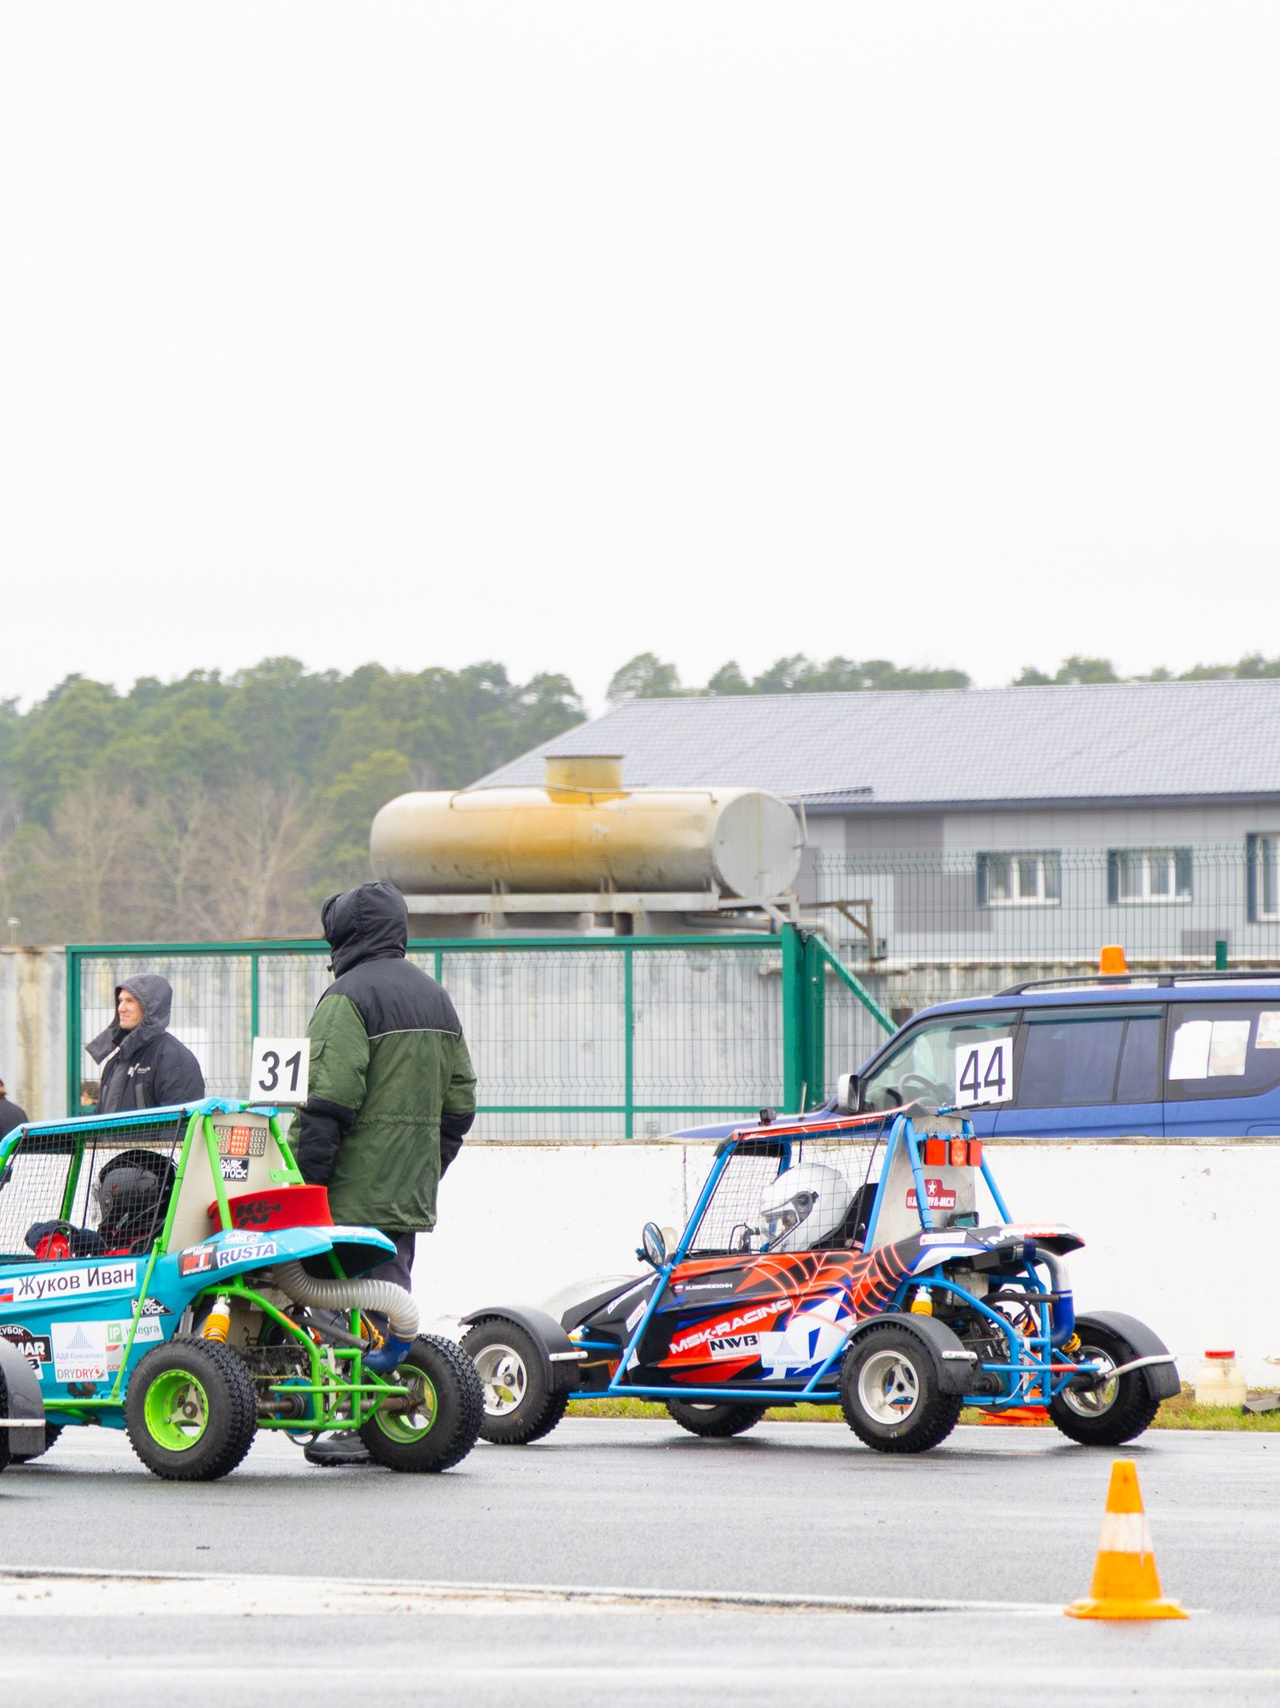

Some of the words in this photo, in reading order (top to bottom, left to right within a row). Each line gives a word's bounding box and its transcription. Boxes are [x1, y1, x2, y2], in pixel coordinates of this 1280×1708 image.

[258, 1050, 302, 1092] 31
[959, 1046, 1006, 1101] 44
[219, 1243, 275, 1266] RUSTA
[18, 1275, 80, 1299] Жуков
[87, 1267, 134, 1288] Иван
[126, 1325, 160, 1336] iegra
[669, 1299, 792, 1354] MSK-RACING
[710, 1335, 758, 1351] NWB
[57, 1368, 94, 1379] DRYDRY
